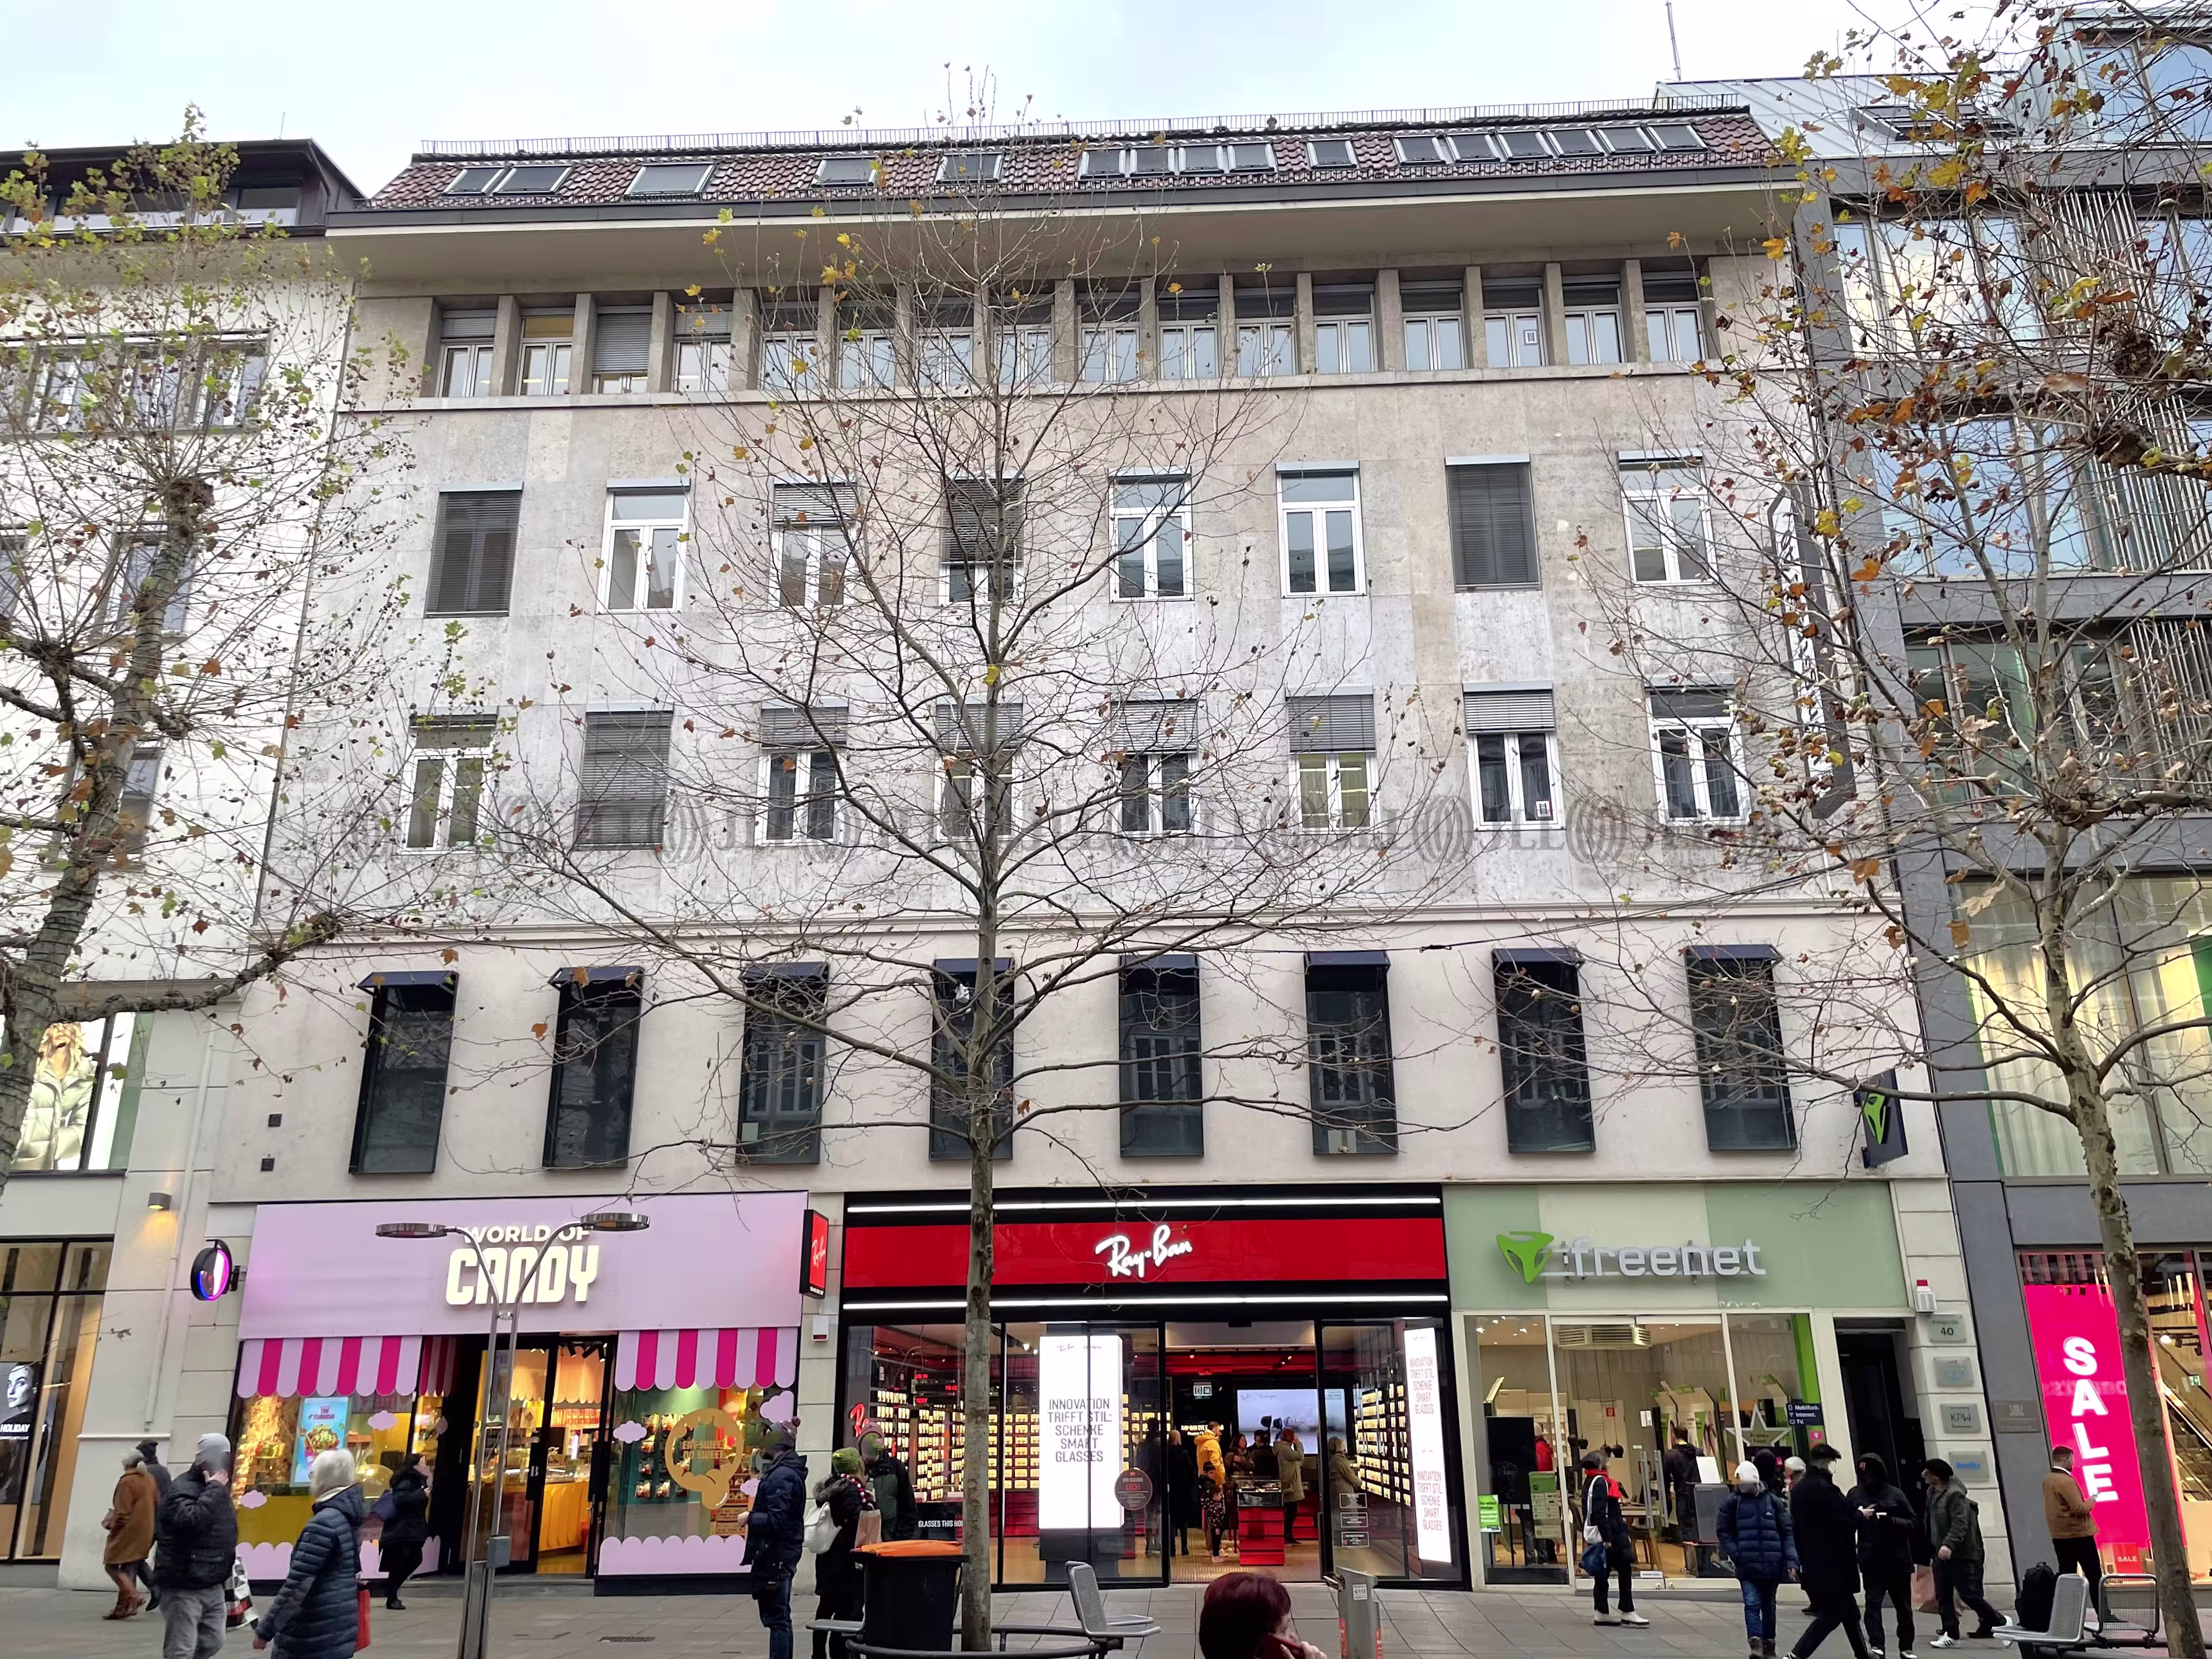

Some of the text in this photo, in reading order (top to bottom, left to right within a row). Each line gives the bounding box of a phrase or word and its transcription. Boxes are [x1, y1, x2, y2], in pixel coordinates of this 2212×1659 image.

[464, 1225, 589, 1243] WORLD OF
[1095, 1225, 1193, 1278] Ray-Ban
[1570, 1236, 1767, 1277] freenet
[445, 1245, 600, 1305] CANDY
[1941, 1327, 1954, 1335] 40
[1416, 1392, 1431, 1403] SMART
[1047, 1411, 1083, 1423] TRIFFT
[2063, 1336, 2119, 1502] SALE
[0, 1423, 31, 1433] HOLIDAY
[1055, 1424, 1104, 1435] SCHENKE
[1055, 1450, 1103, 1462] GLASSES
[1417, 1470, 1441, 1482] INNOVATION
[1424, 1508, 1439, 1518] SMART
[918, 1520, 941, 1528] GLASSES
[941, 1520, 953, 1528] THIS
